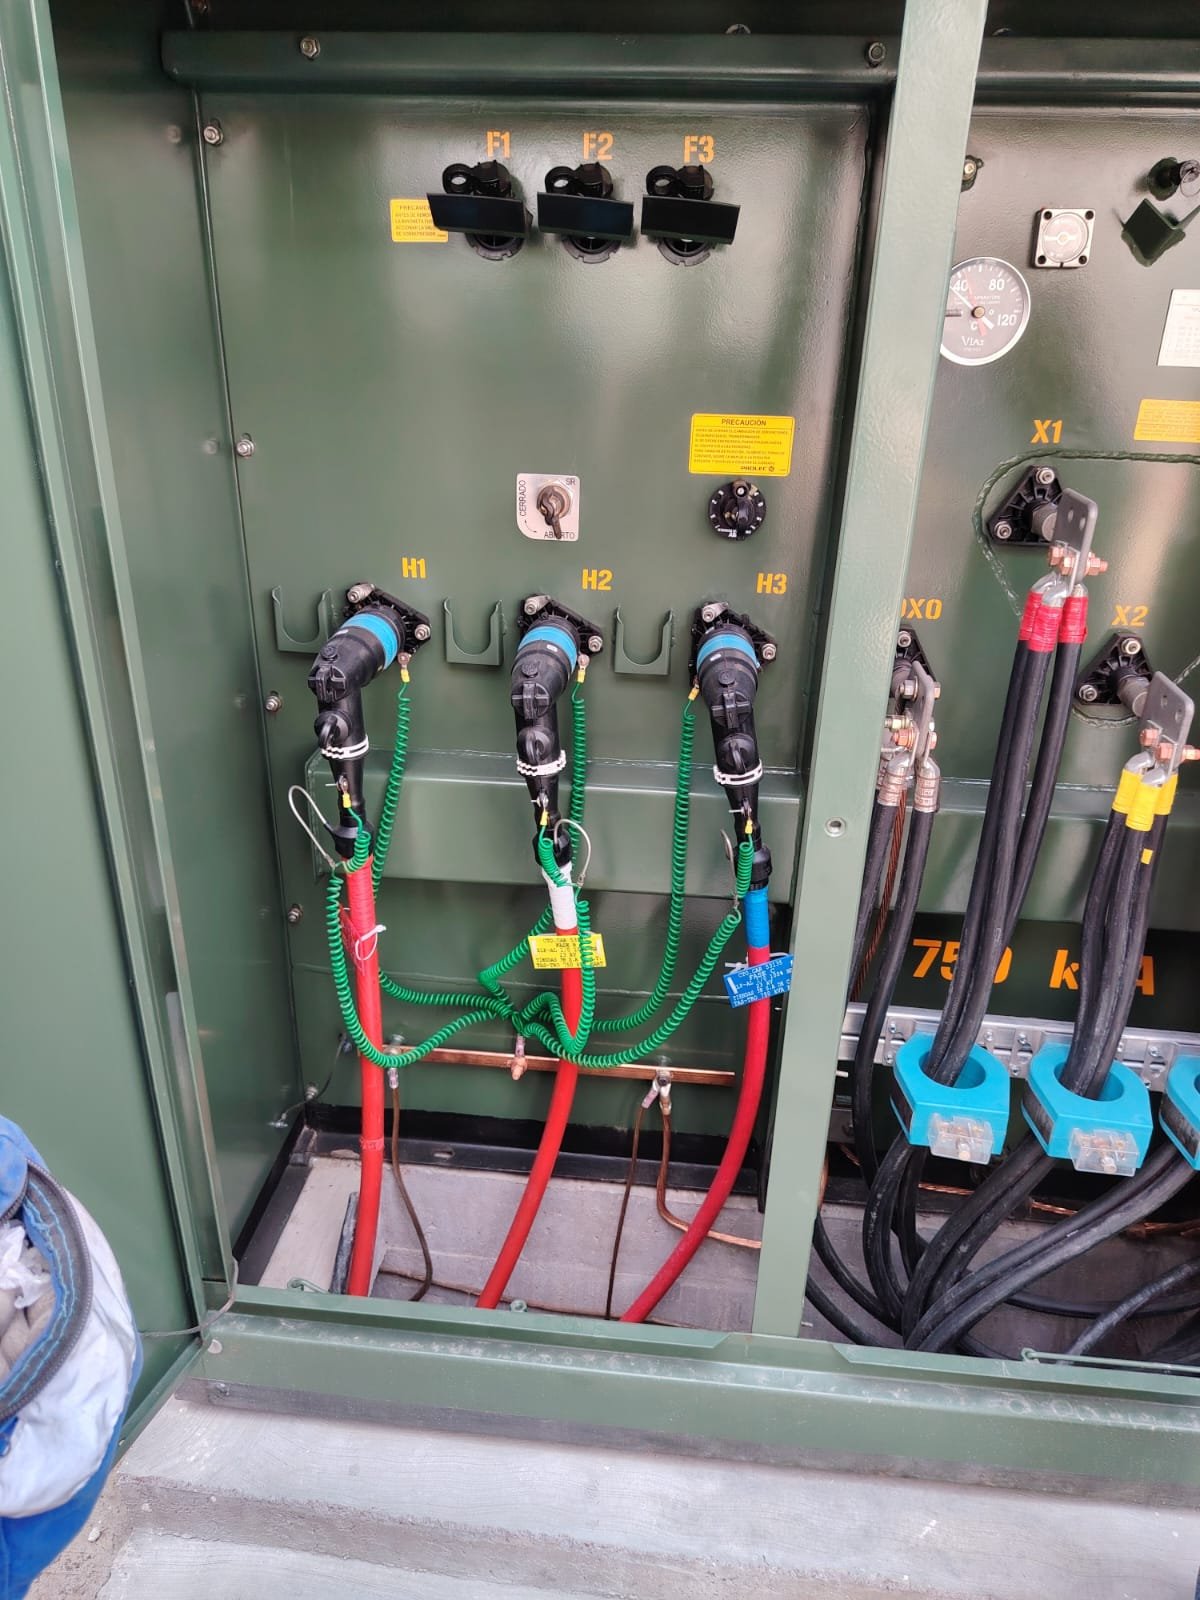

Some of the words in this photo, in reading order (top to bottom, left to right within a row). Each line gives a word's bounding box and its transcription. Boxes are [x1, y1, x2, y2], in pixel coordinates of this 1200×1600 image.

[486, 131, 512, 159] F1
[583, 132, 615, 160] F2
[683, 135, 716, 164] F3
[953, 280, 968, 292] 40
[988, 278, 1005, 291] 80
[997, 314, 1017, 327] 120
[1031, 420, 1064, 446] X1
[518, 480, 527, 517] CERRADO
[402, 558, 427, 579] H1
[582, 569, 614, 592] H2
[757, 573, 789, 596] H3
[1112, 605, 1150, 628] X2
